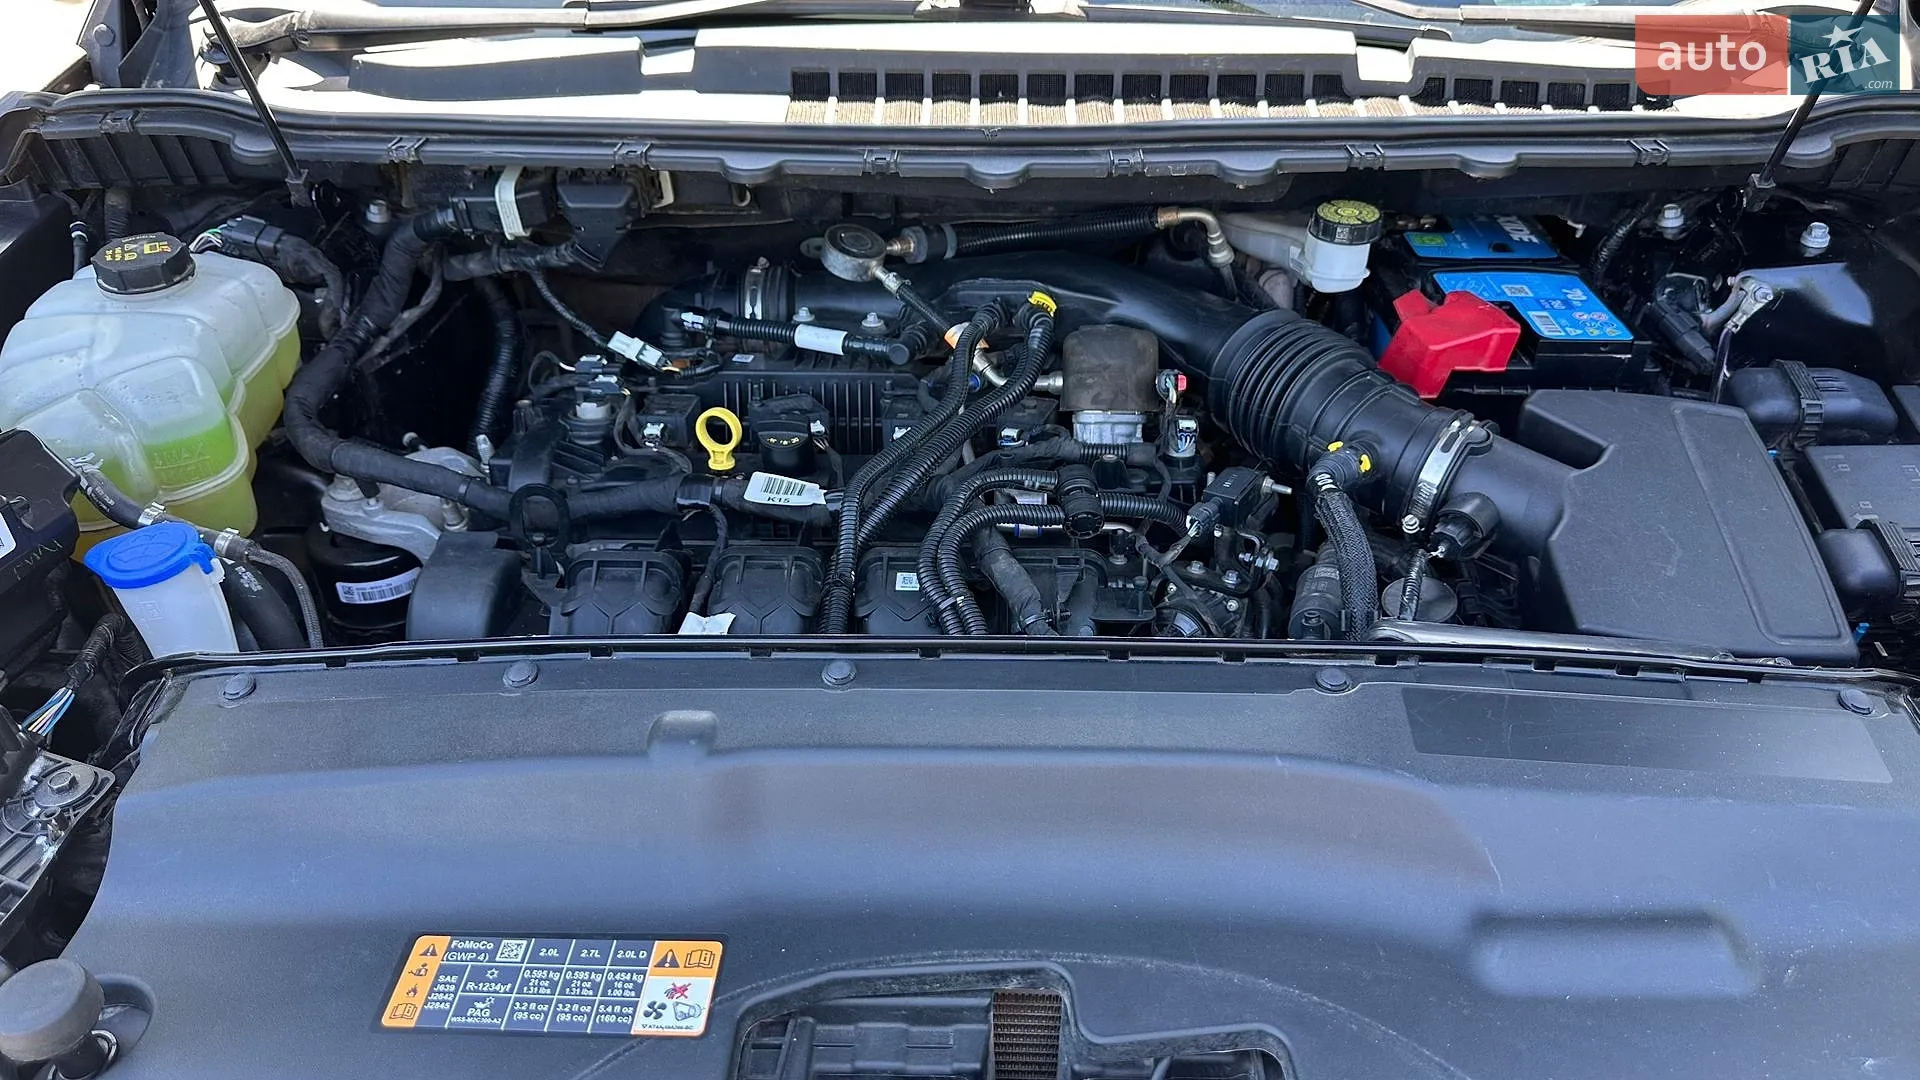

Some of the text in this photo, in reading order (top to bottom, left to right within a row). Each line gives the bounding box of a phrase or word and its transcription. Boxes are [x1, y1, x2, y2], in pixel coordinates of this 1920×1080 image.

[767, 496, 791, 504] K15
[451, 940, 494, 950] FoMoCo
[443, 952, 489, 962] (GWP 4)
[539, 948, 559, 957] 2.0L
[580, 949, 601, 958] 2.7L
[616, 950, 648, 959] 2.0L D
[438, 975, 458, 983] SAE
[523, 970, 561, 981] 0.595 kg
[565, 971, 602, 982] 0.595 kg
[607, 972, 644, 983] 0.454 kg
[465, 981, 512, 993] R-1234yf
[523, 986, 537, 994] 1.31
[513, 1002, 527, 1010] 3.2
[556, 1003, 570, 1012] 3.2
[598, 1005, 613, 1013] 5.4
[467, 1008, 491, 1017] PAG
[513, 1012, 528, 1021] (95
[556, 1013, 571, 1022] (95
